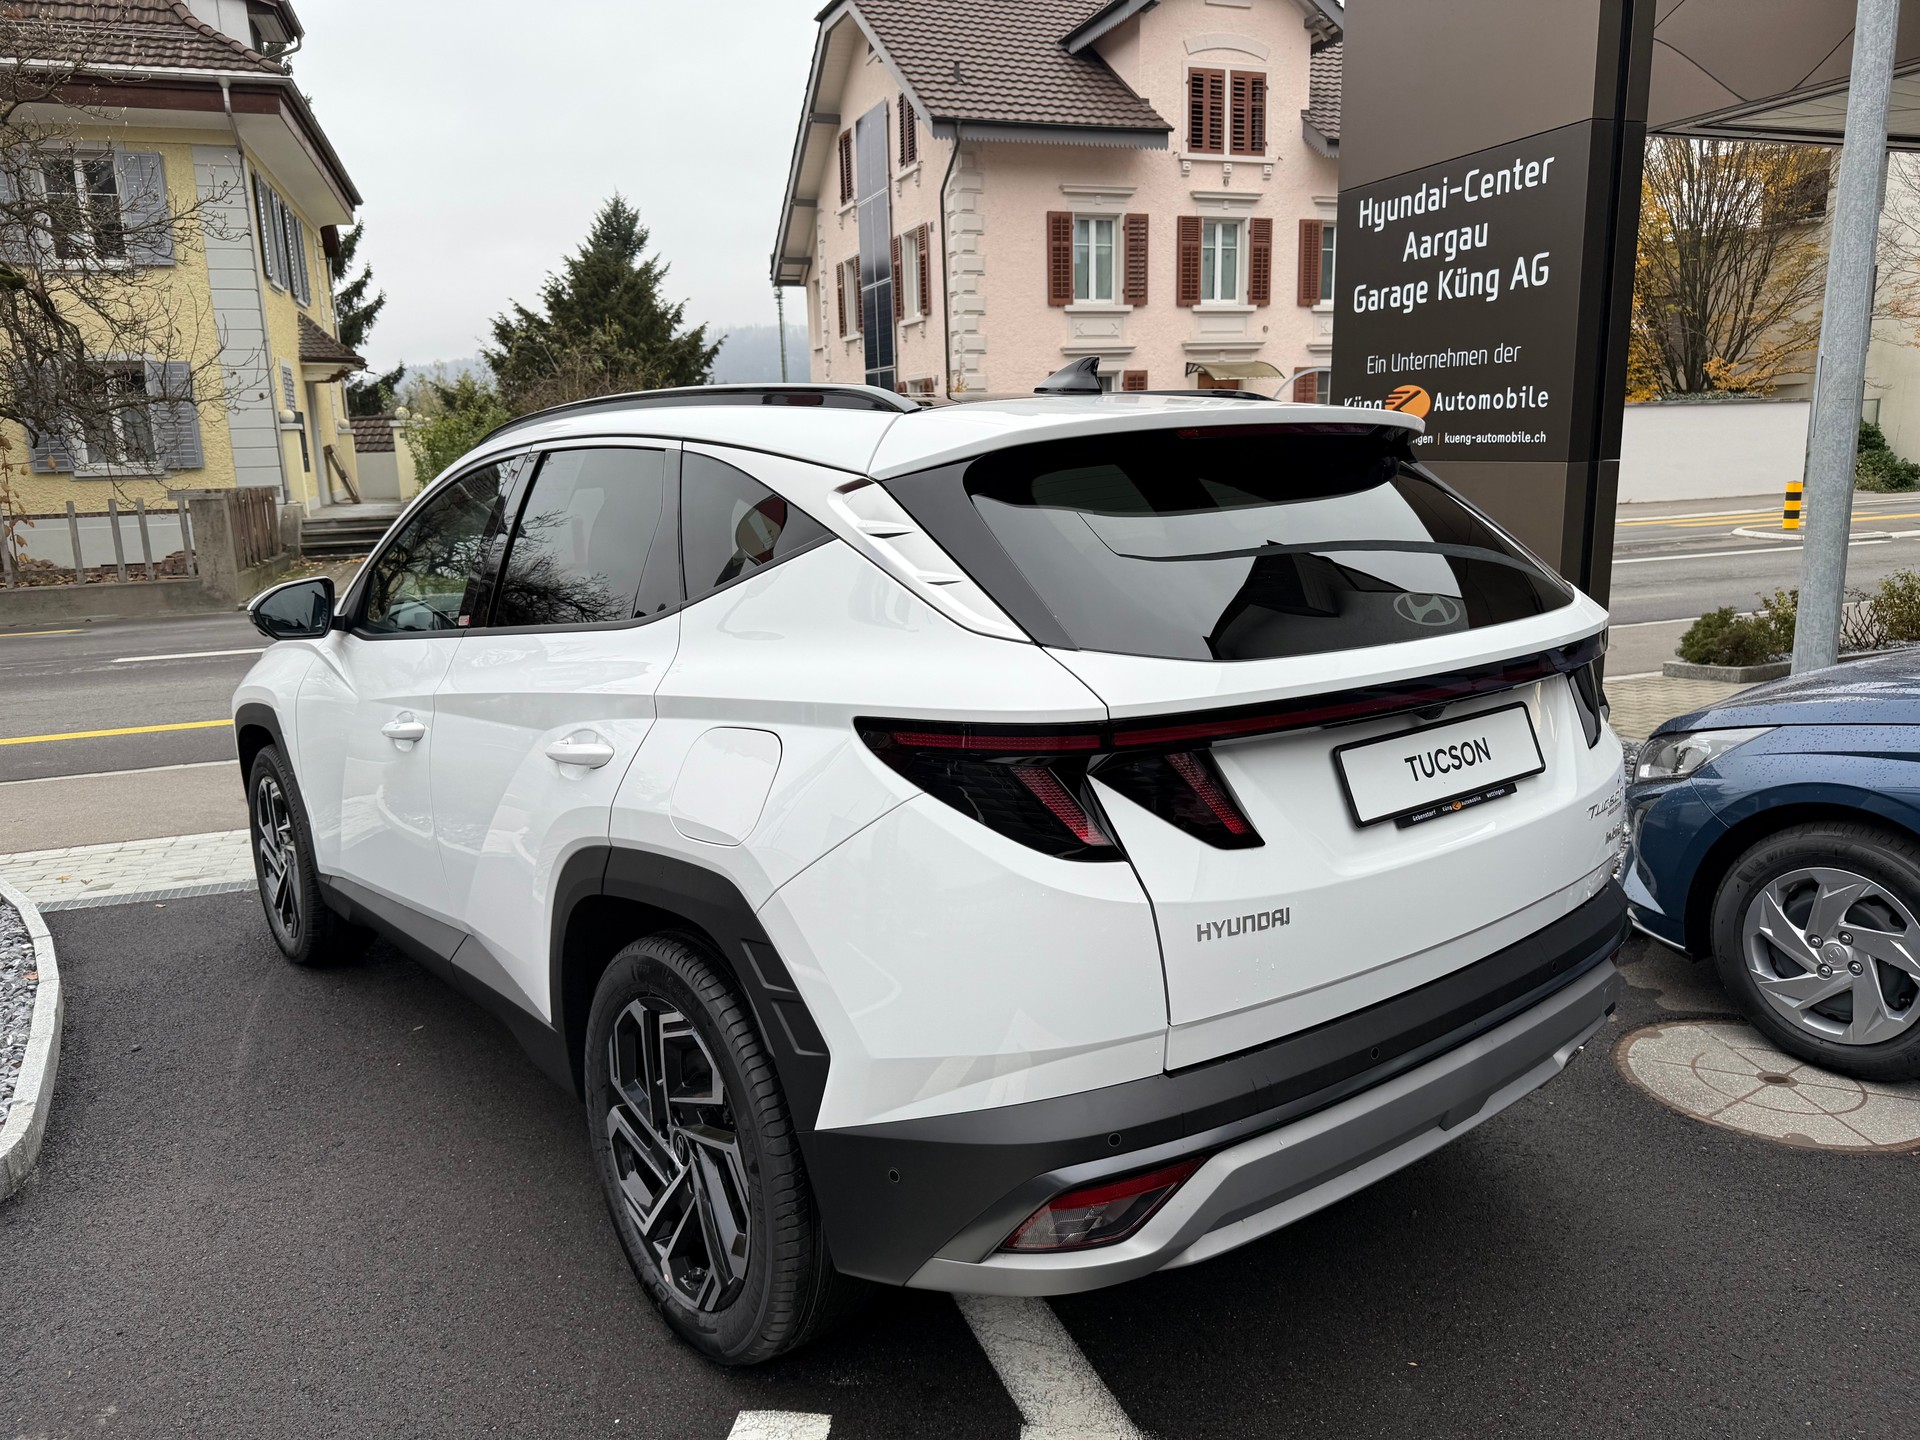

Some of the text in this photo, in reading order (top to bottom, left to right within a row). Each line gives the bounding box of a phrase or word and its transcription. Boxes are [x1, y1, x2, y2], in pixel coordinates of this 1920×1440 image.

[1358, 156, 1555, 232] Hyundai-Center
[1402, 222, 1489, 263] Aargau
[1353, 251, 1550, 314] Garage Küng AG
[1366, 343, 1522, 375] Ein Unternehmen der
[1433, 385, 1549, 412] Automobile
[1444, 430, 1547, 446] kueng-automobile.ch
[1404, 736, 1492, 782] TUCSON
[1196, 906, 1290, 942] HYUNDAI
